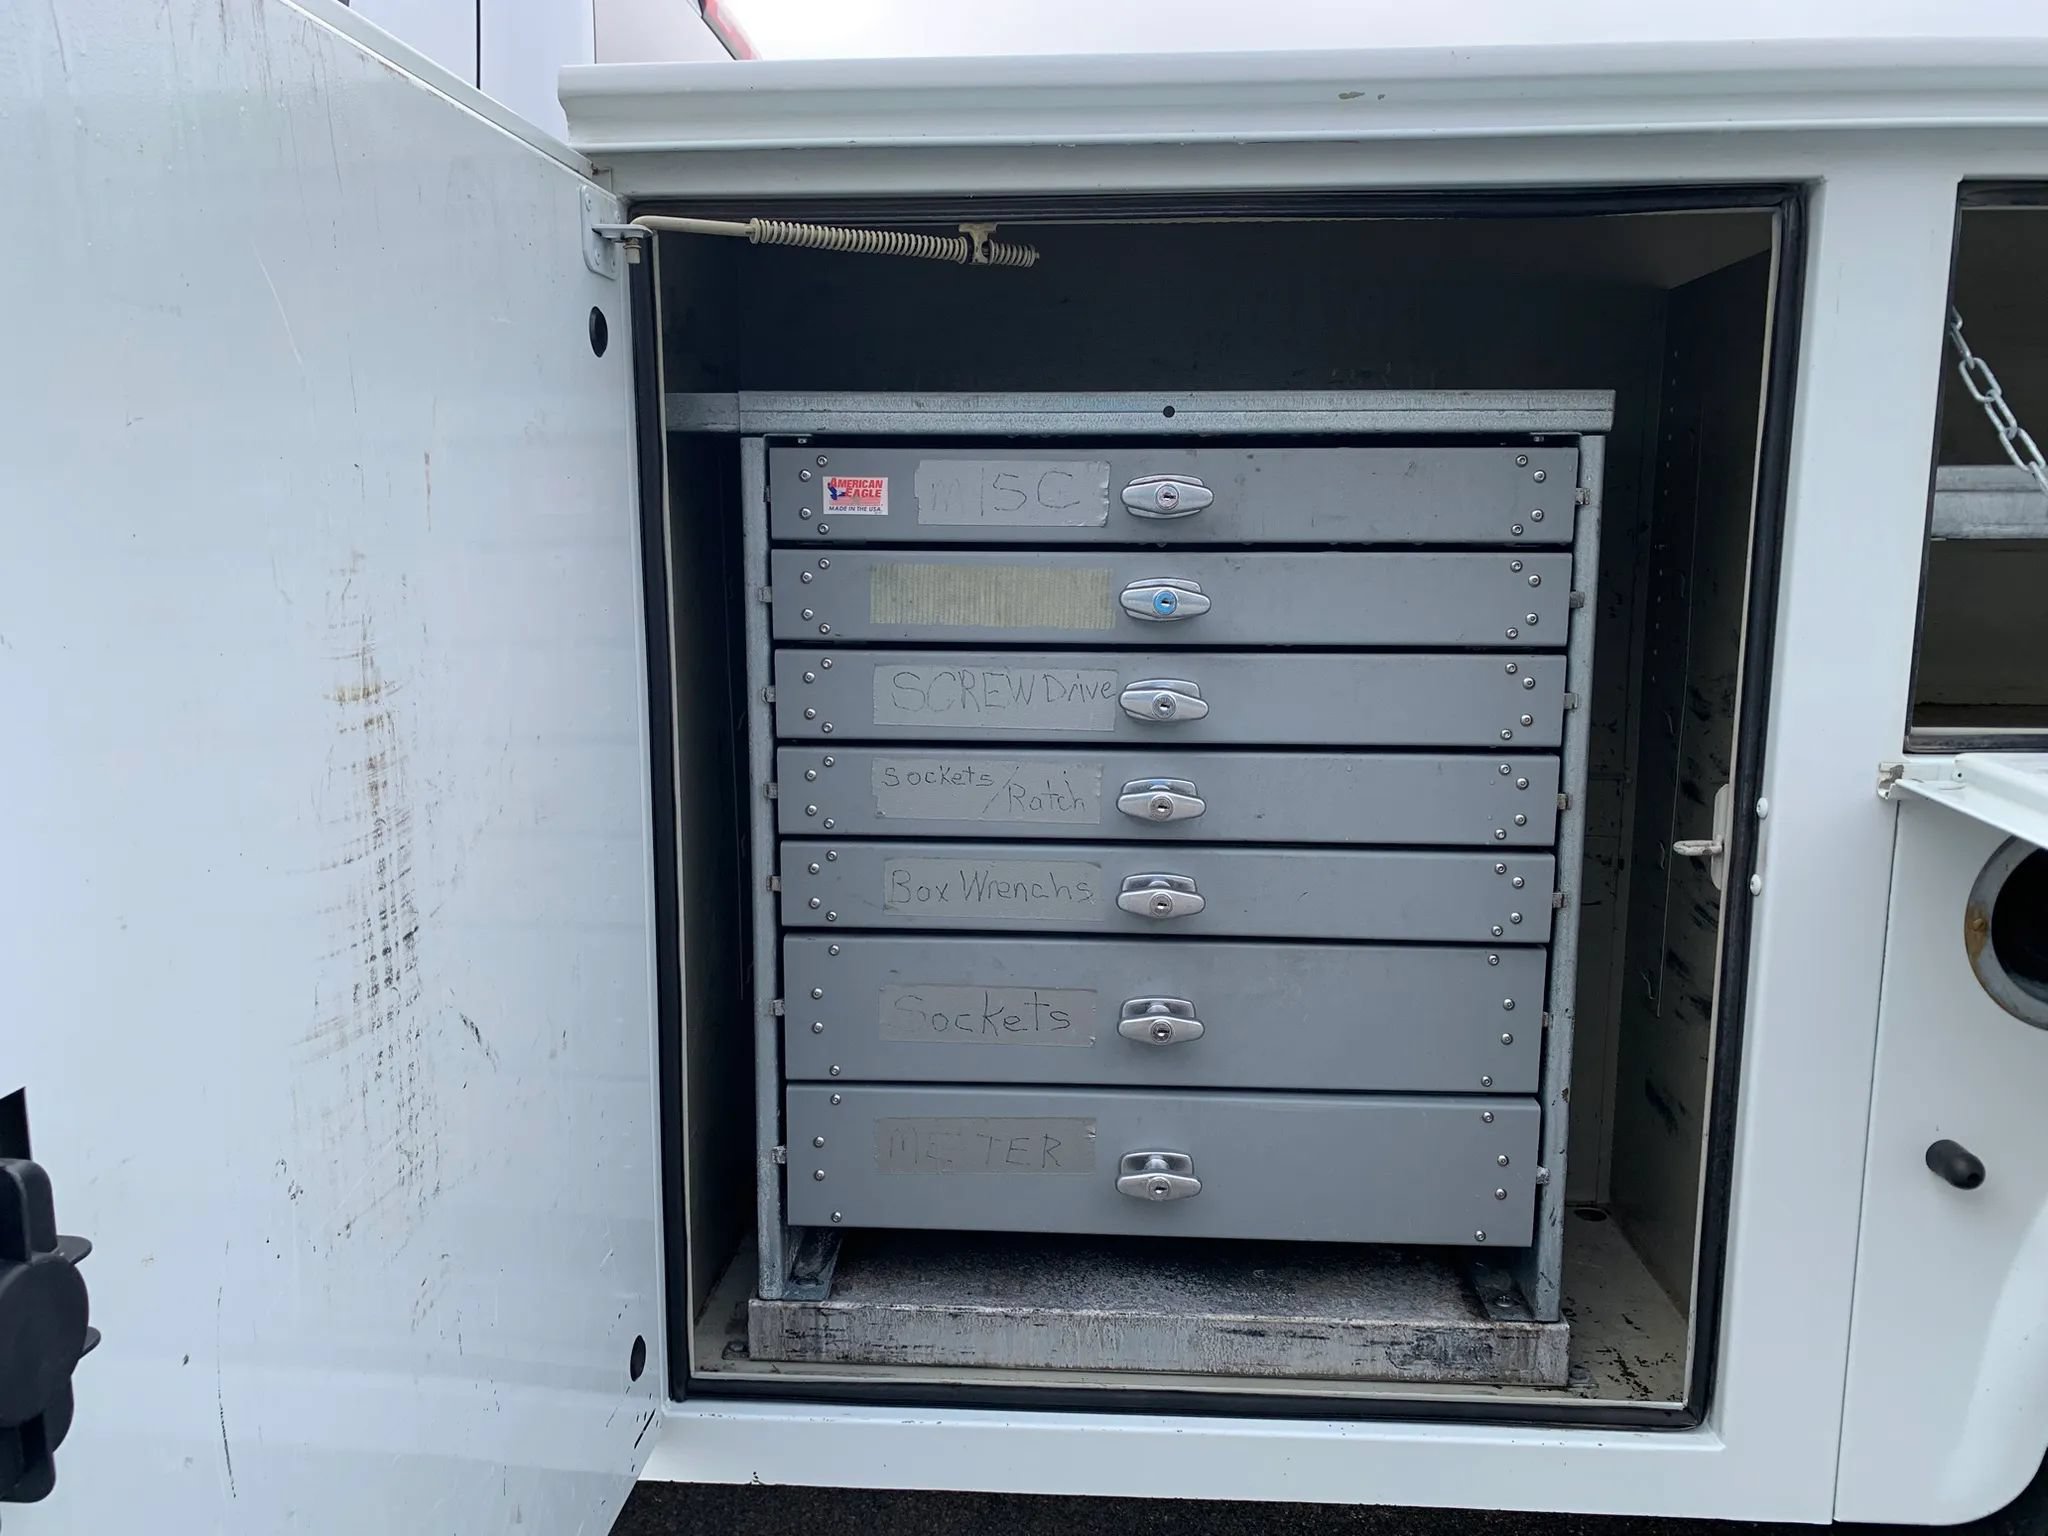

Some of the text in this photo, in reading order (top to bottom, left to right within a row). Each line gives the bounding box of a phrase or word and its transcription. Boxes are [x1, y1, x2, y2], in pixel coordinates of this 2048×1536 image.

[830, 478, 883, 489] AMERICAN
[846, 488, 882, 498] EAGLE
[888, 869, 1094, 904] Box Wrenchs
[889, 990, 1071, 1037] Sockets
[889, 1128, 1062, 1169] METER
